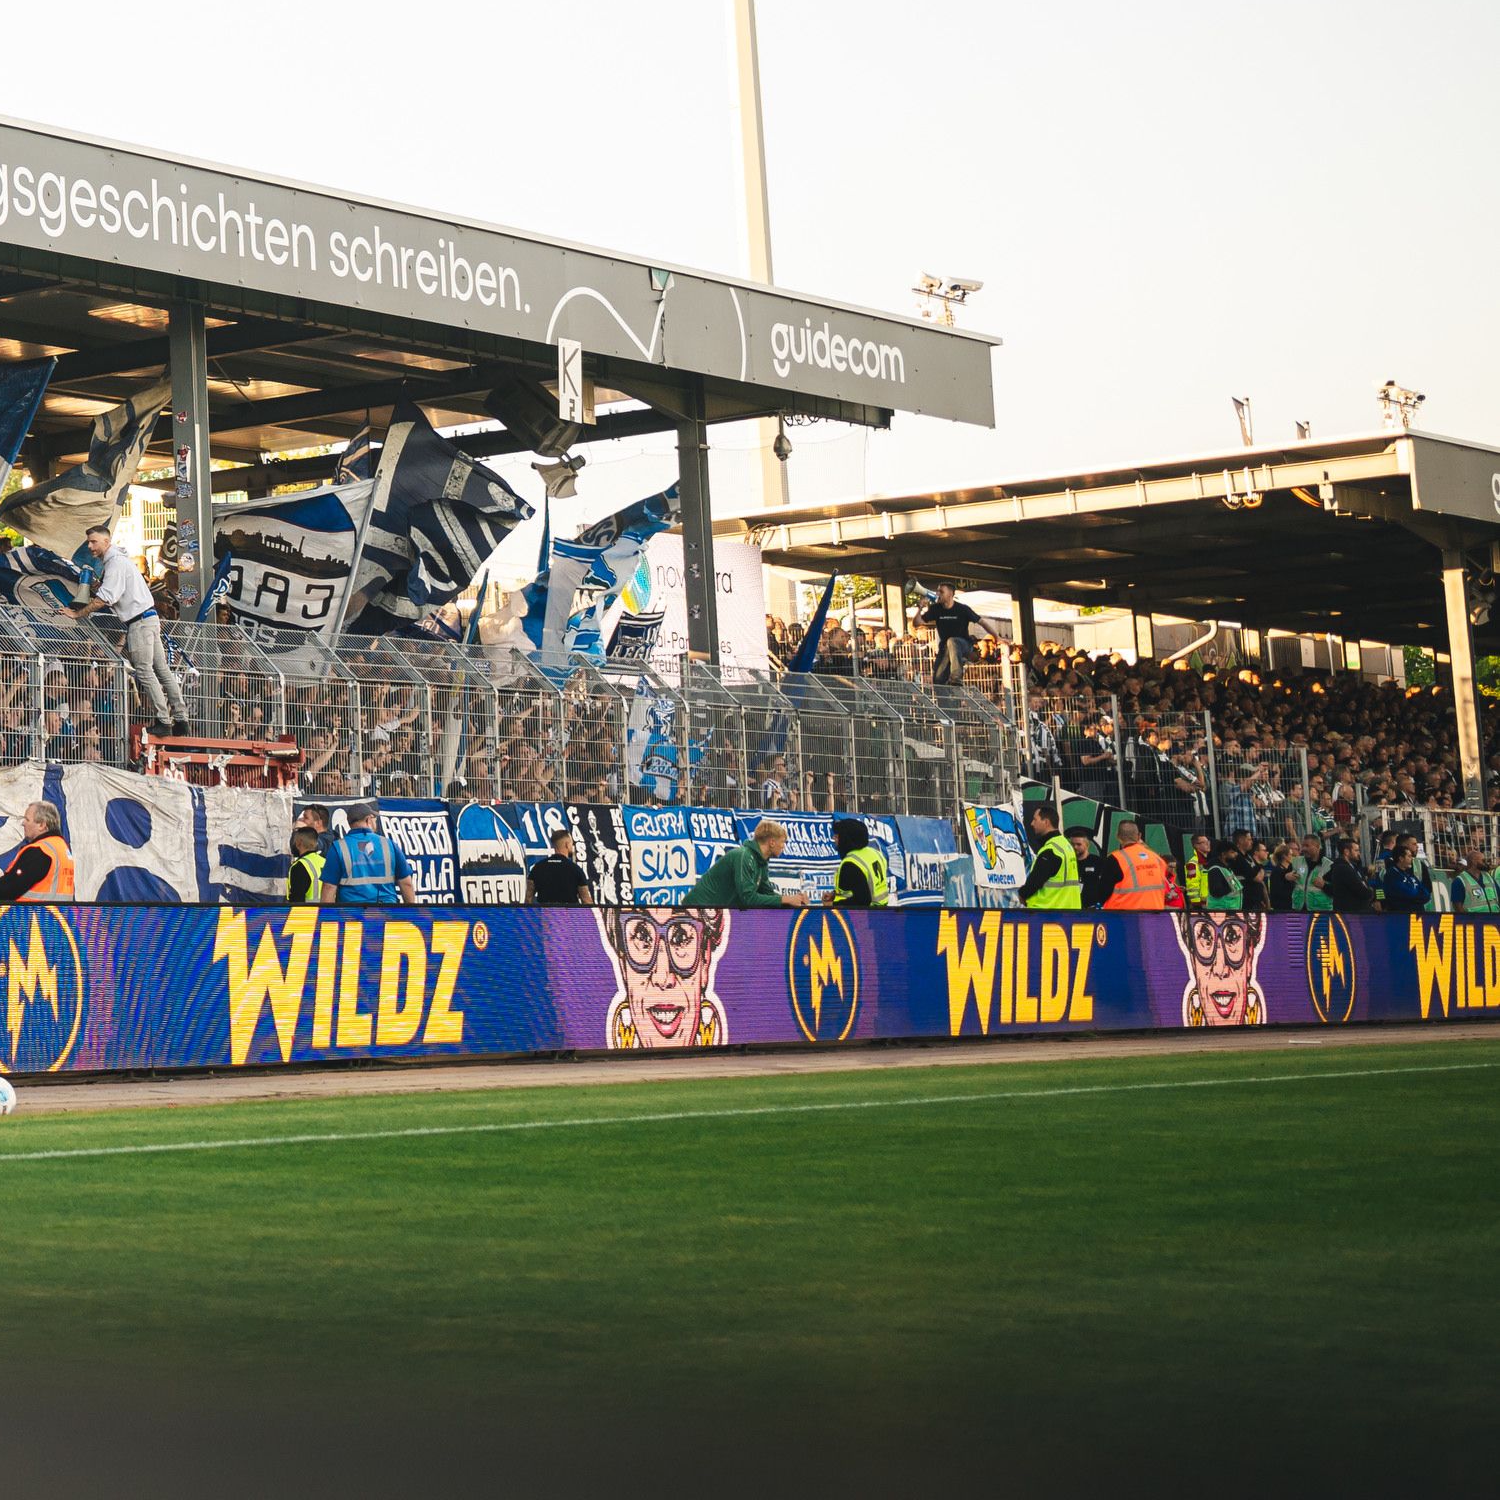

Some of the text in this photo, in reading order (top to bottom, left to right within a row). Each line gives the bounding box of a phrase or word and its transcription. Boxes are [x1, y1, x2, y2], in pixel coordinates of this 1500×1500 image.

[330, 230, 531, 314] schreiben.
[562, 347, 580, 397] K
[771, 322, 905, 384] guidecom
[638, 844, 690, 882] SÜD
